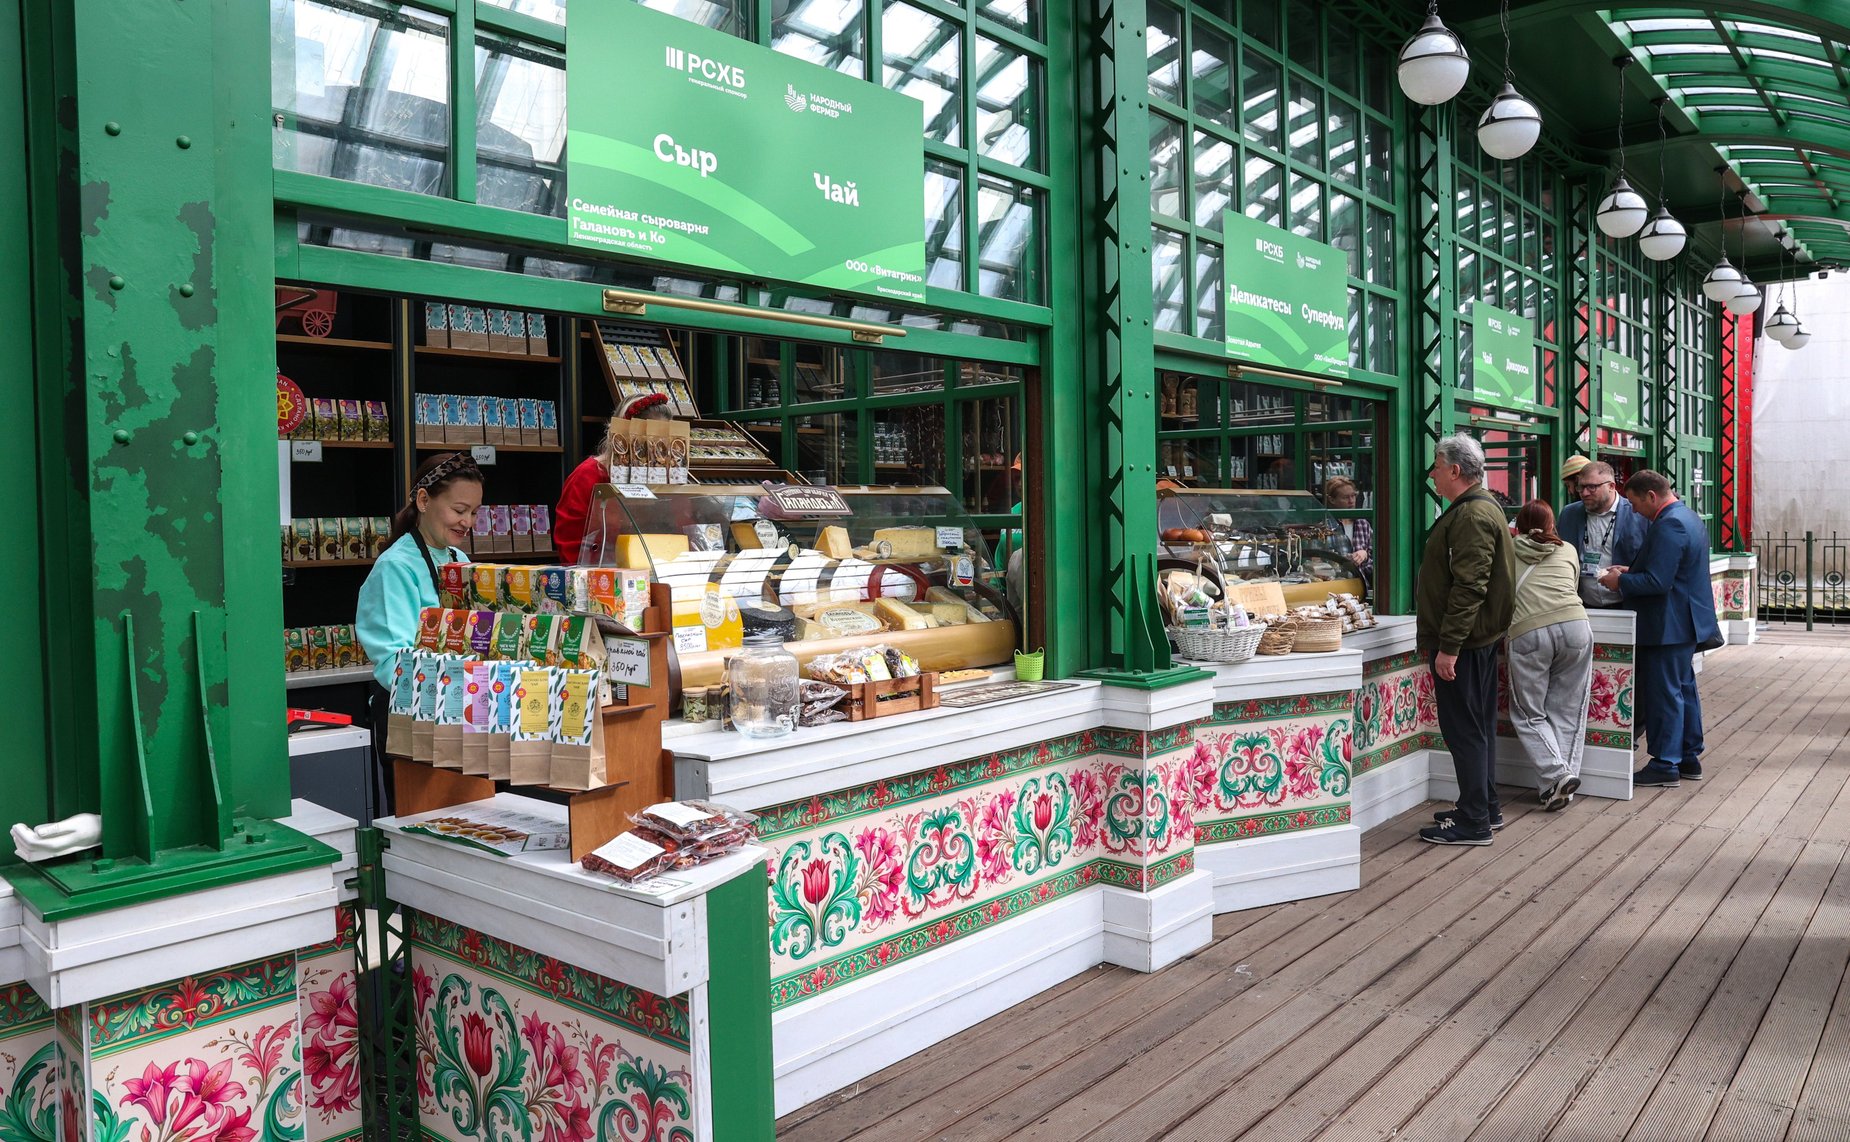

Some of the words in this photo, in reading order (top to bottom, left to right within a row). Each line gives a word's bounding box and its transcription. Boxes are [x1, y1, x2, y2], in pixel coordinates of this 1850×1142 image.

[688, 53, 745, 89] РСХБ
[810, 93, 852, 113] НАРОДНЫЙ
[810, 104, 840, 118] ФЕРМЕР
[653, 133, 717, 178] Сыр
[814, 172, 859, 207] Чай
[573, 198, 638, 221] Семейная
[641, 213, 709, 235] сыроварня
[573, 217, 636, 238] Галановъ
[638, 231, 647, 241] и
[649, 230, 666, 244] Ко
[574, 232, 625, 246] Ленинградская
[626, 241, 652, 251] область
[1263, 240, 1283, 258] РСХБ
[846, 260, 868, 273] ООО
[870, 265, 922, 282] «Витагрин»
[1230, 284, 1292, 315] Деликатесы
[1301, 303, 1344, 331] Суперфуд
[1482, 351, 1493, 365] Чай
[1505, 358, 1529, 375] Дикоросы
